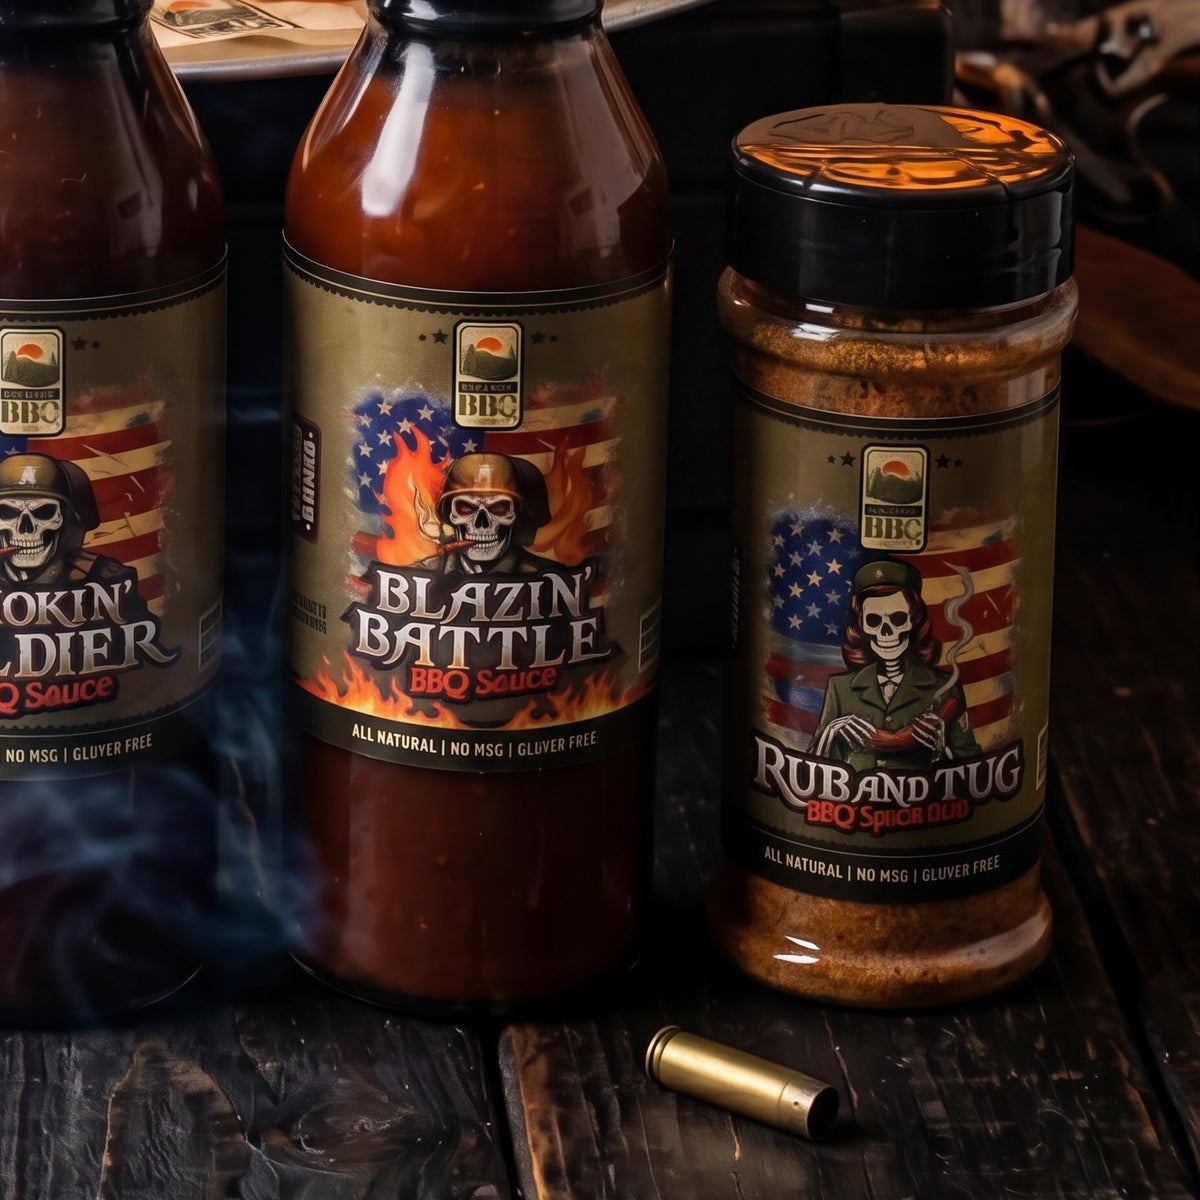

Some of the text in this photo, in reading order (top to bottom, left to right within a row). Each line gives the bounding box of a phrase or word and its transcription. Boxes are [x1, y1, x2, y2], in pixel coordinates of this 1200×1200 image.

[375, 566, 592, 625] BLAZIN'
[355, 608, 612, 670] BATTLE
[25, 675, 113, 708] Sauce
[409, 666, 558, 700] BBQ Sauce
[6, 748, 25, 763] NO
[29, 748, 58, 763] MSG
[125, 733, 153, 752] FREE
[352, 723, 374, 742] ALL
[377, 730, 437, 753] NATURAL
[451, 741, 470, 756] NO
[474, 742, 504, 757] MSG
[569, 730, 597, 749] FREE
[753, 736, 1022, 808] RUB AND TUG
[764, 845, 783, 864] ALL
[785, 853, 843, 879] NATURAL
[856, 867, 876, 882] NO
[880, 868, 909, 883] MSG
[973, 854, 1000, 874] FREE
